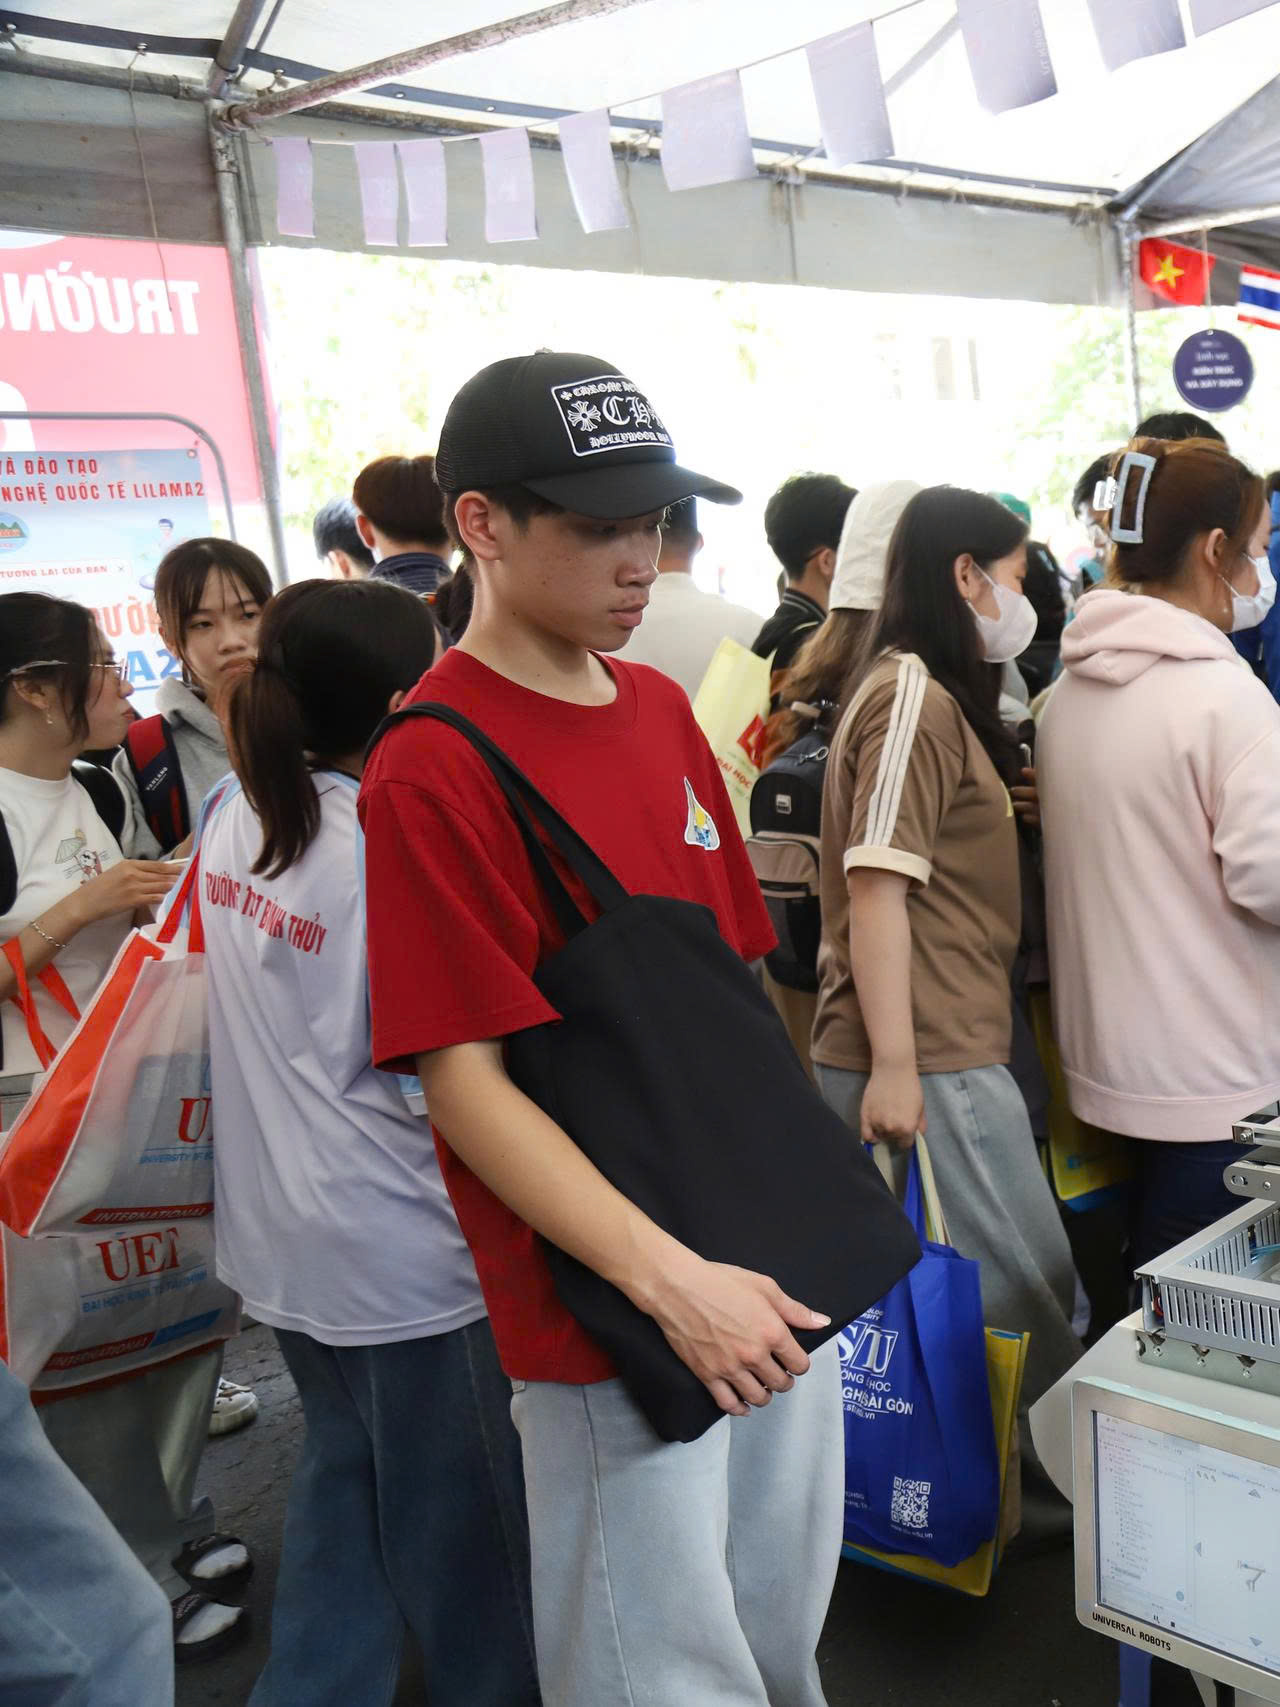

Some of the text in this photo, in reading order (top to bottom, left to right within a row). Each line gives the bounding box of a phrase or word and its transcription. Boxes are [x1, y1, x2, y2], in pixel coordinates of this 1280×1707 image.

[67, 459, 98, 477] TẠO
[133, 482, 205, 499] LILAMA2
[178, 1097, 213, 1143] U
[1092, 1611, 1172, 1652] UNIVERSAL ROBOTS
